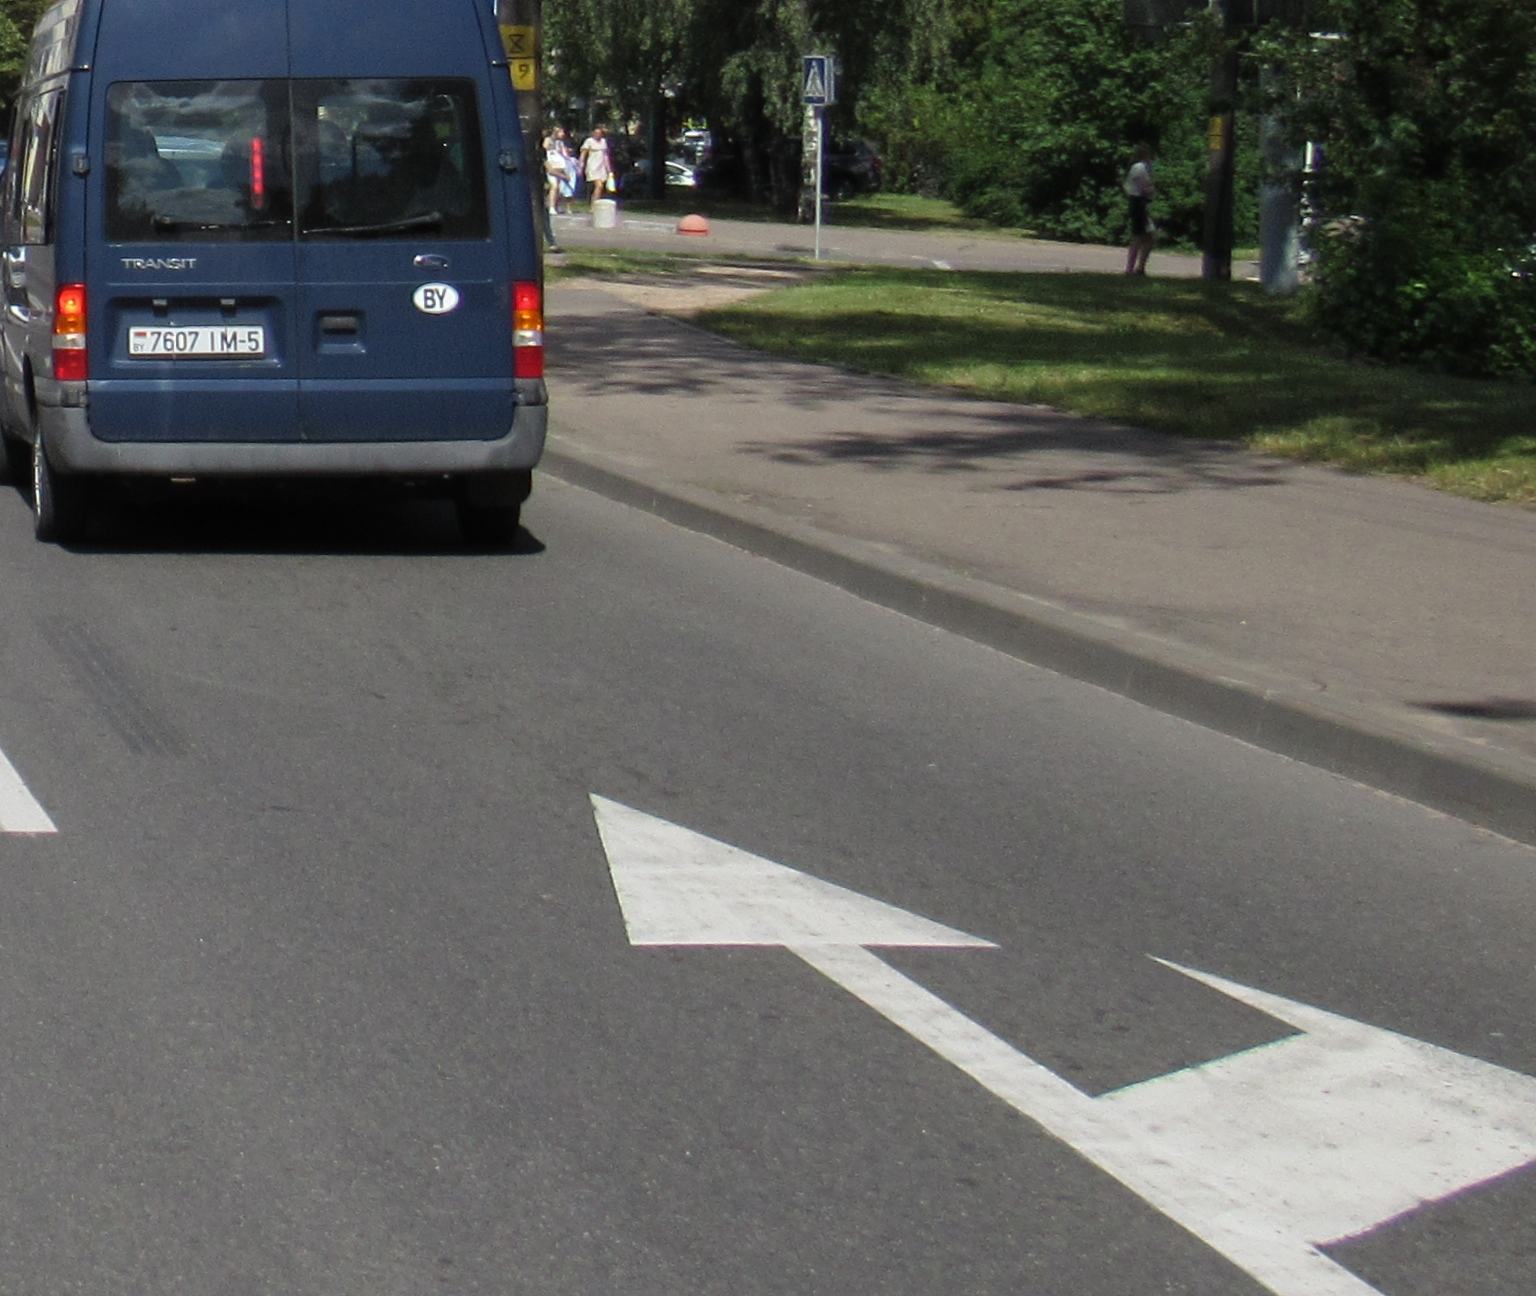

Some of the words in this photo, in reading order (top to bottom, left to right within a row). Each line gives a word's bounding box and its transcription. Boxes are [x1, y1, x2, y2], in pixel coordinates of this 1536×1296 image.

[120, 257, 197, 270] TRANSIT
[423, 287, 447, 309] BY
[150, 331, 200, 352] 7607
